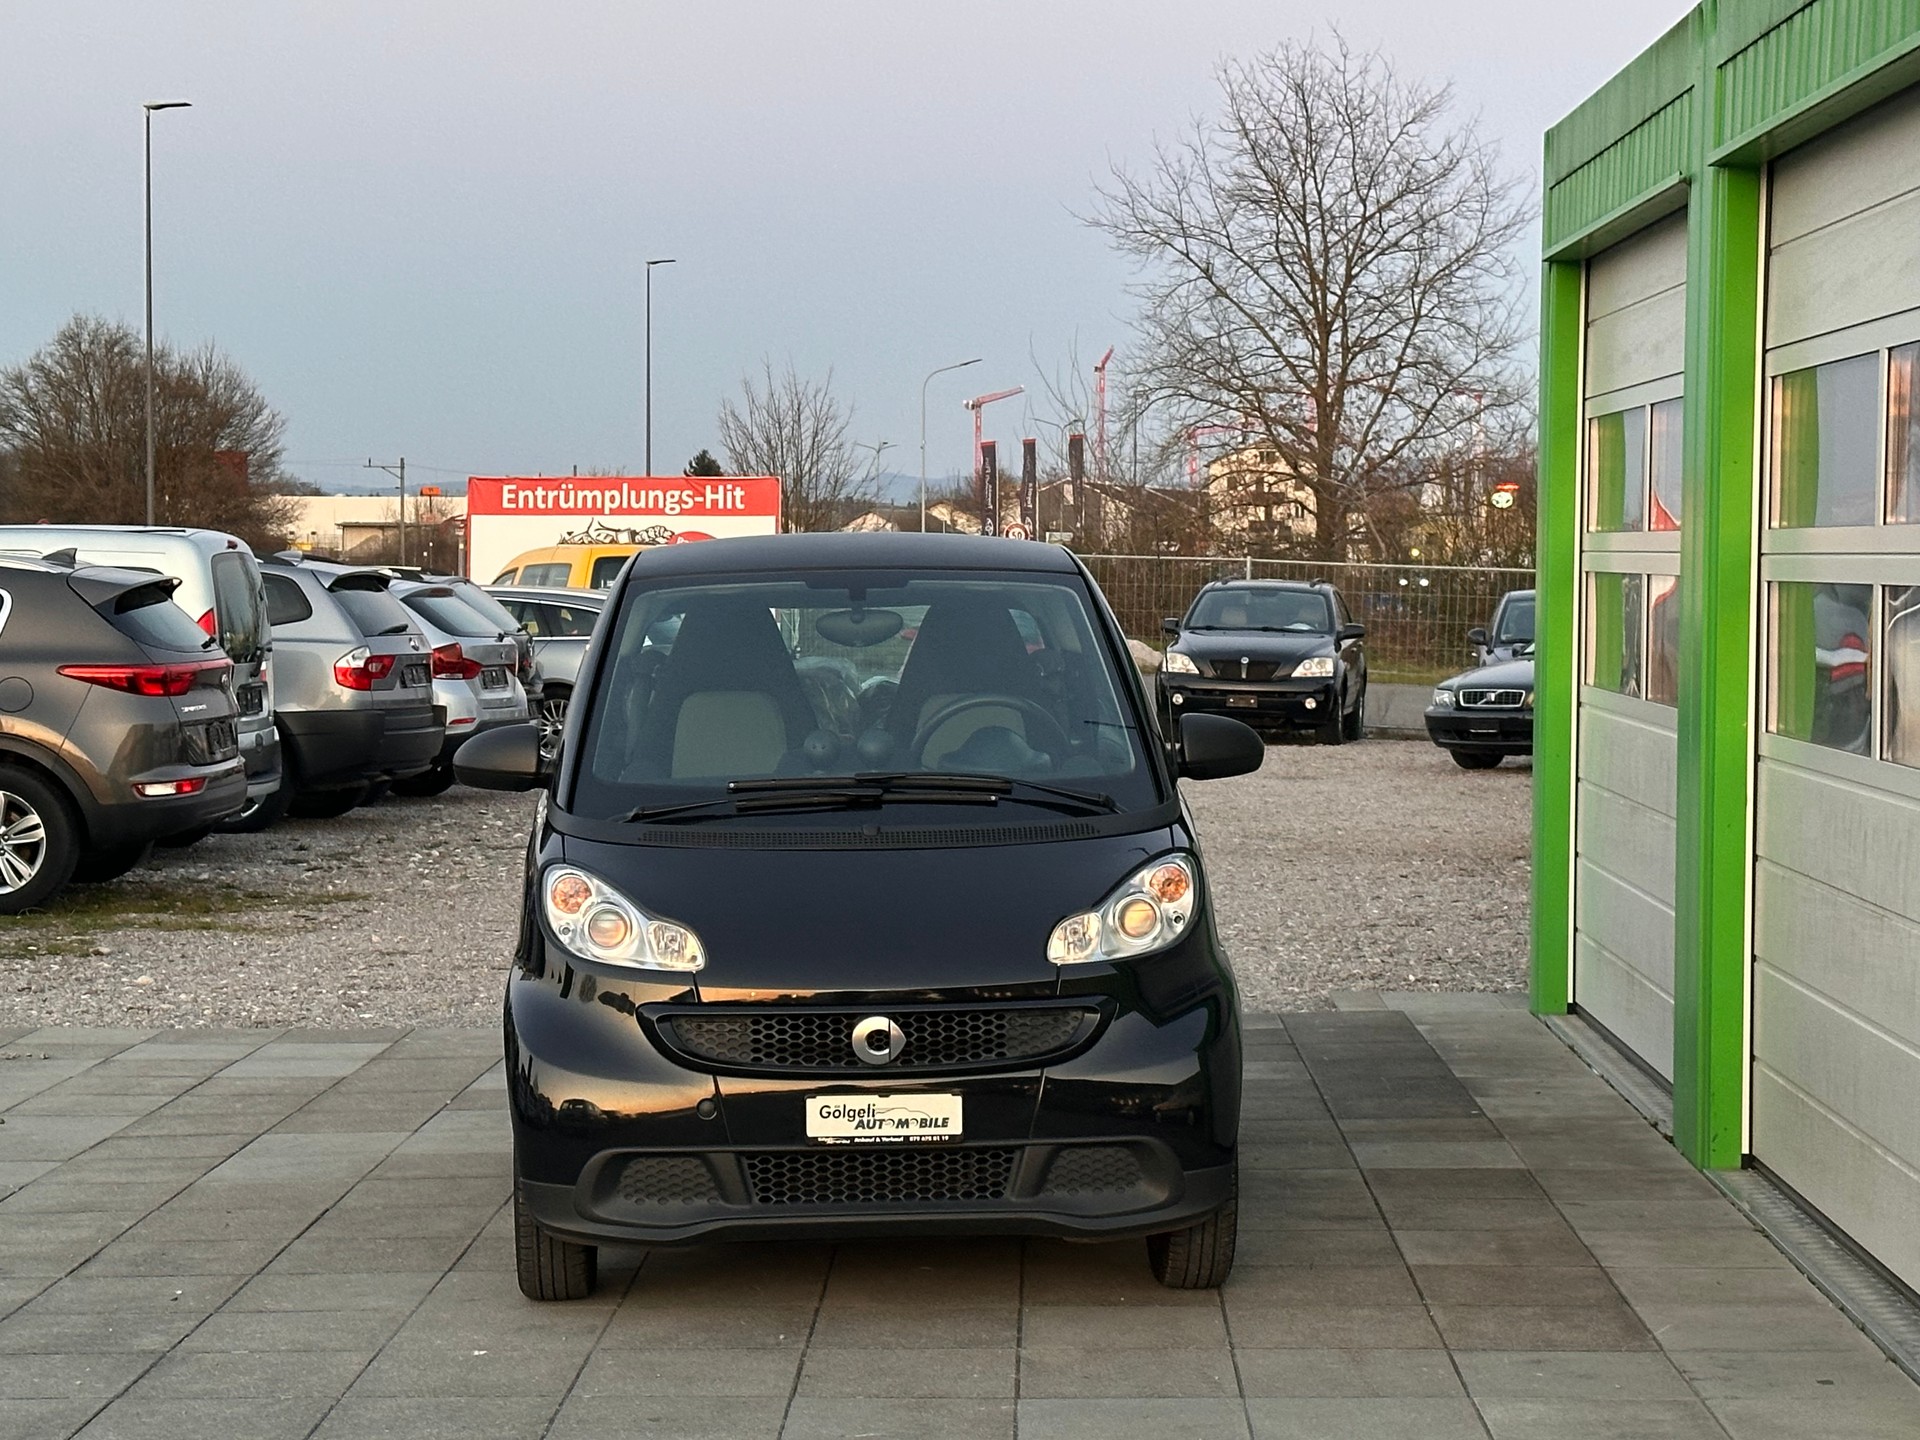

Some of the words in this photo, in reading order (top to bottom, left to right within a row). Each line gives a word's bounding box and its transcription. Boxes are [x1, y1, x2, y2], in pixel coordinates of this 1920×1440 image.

[502, 483, 746, 515] Entrümplungs-Hit
[819, 1103, 876, 1122] Gölgeli
[854, 1117, 950, 1130] AUTOMOBILE
